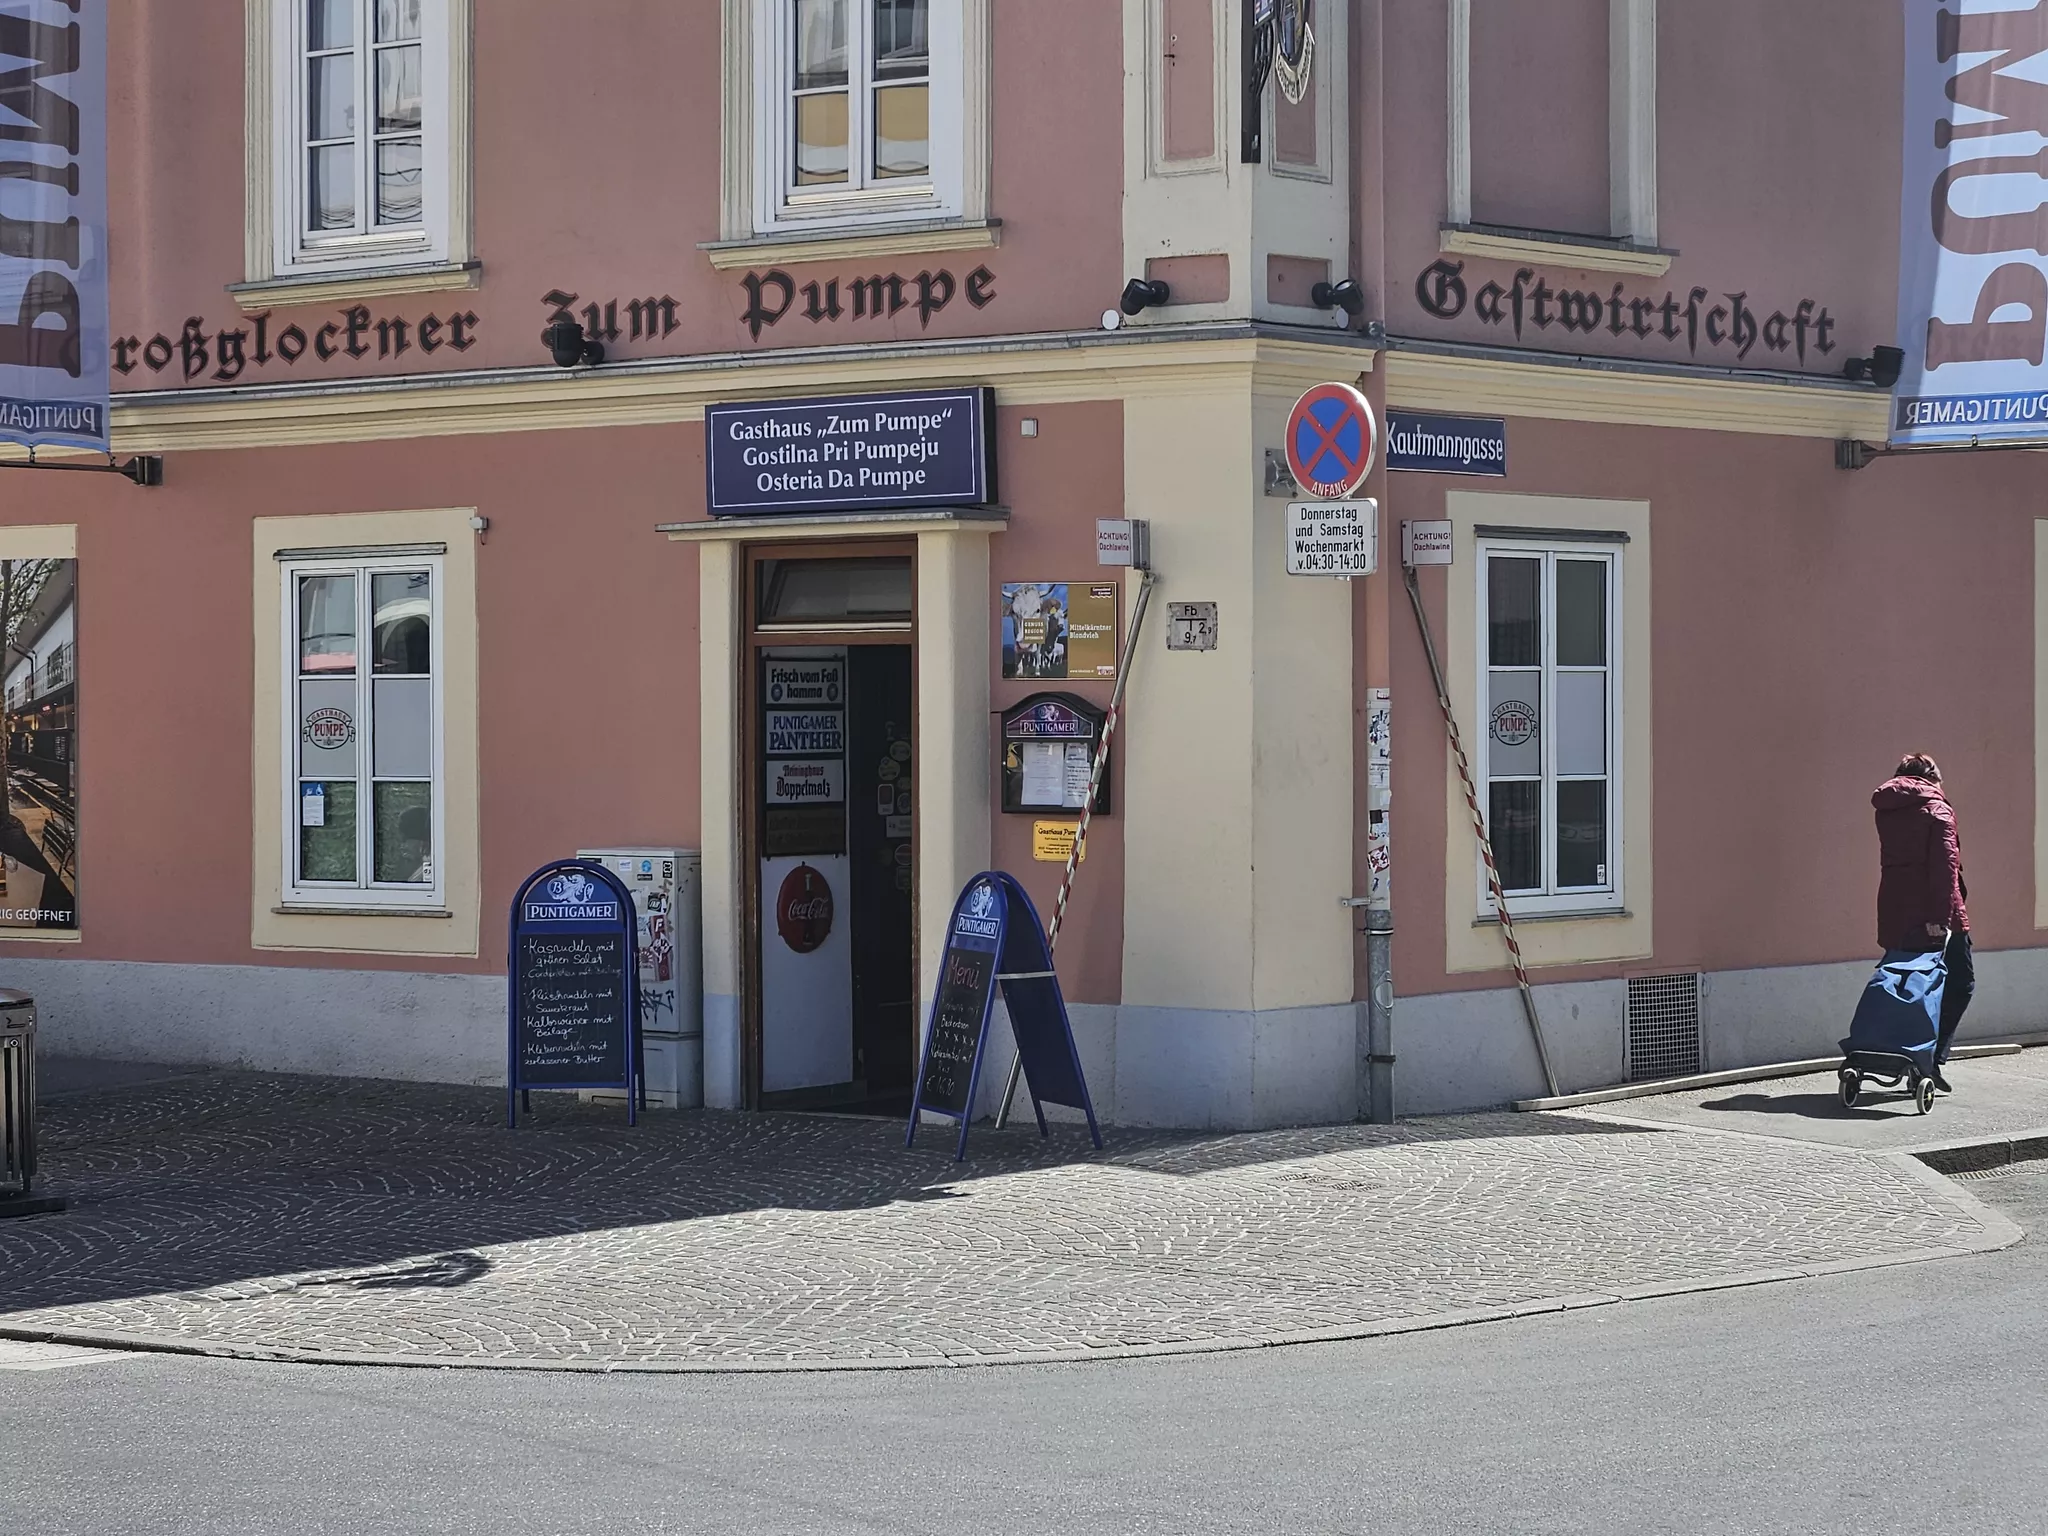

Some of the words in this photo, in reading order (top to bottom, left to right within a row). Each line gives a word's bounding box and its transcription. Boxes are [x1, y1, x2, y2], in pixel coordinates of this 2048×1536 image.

[540, 288, 681, 349] Zum
[739, 264, 997, 343] Pumpe
[729, 418, 812, 441] Gasthaus
[1386, 420, 1503, 464] Kaufmanngasse
[743, 444, 818, 466] Gostilna
[823, 440, 849, 462] Pri
[854, 437, 939, 464] Pumpeju
[757, 469, 823, 492] Osteria
[828, 469, 854, 488] Da
[859, 467, 926, 490] Pumpe
[1311, 479, 1348, 497] ANFANG
[1300, 507, 1358, 521] Donnerstag
[1295, 523, 1313, 537] und
[1320, 522, 1364, 537] Samstag
[1413, 532, 1451, 541] ACHTUNG!
[1099, 542, 1129, 551] Dachlawine
[1295, 539, 1364, 554] Wochenmarkt
[1413, 542, 1451, 551] Dachlawine
[1184, 605, 1198, 616] Fb
[771, 668, 799, 683] Frisch
[800, 671, 820, 683] vom
[821, 667, 838, 684] Faß
[787, 684, 822, 699] hamma
[314, 723, 344, 737] PUMPE
[773, 715, 837, 730] PUNTIGAMER
[1023, 722, 1075, 732] PUNTIGAMER
[1500, 717, 1527, 732] PUMPE
[769, 731, 842, 751] PANTHER
[15, 907, 72, 922] GEÖFFNET
[531, 905, 612, 919] PUNTIGAMER
[958, 916, 996, 935] PUNTIGAMER
[529, 938, 592, 954] Kasnudeln
[596, 939, 614, 952] mit
[573, 954, 603, 965] Salat
[596, 987, 613, 998] mit
[593, 1014, 614, 1024] mit
[589, 1041, 608, 1051] mit
